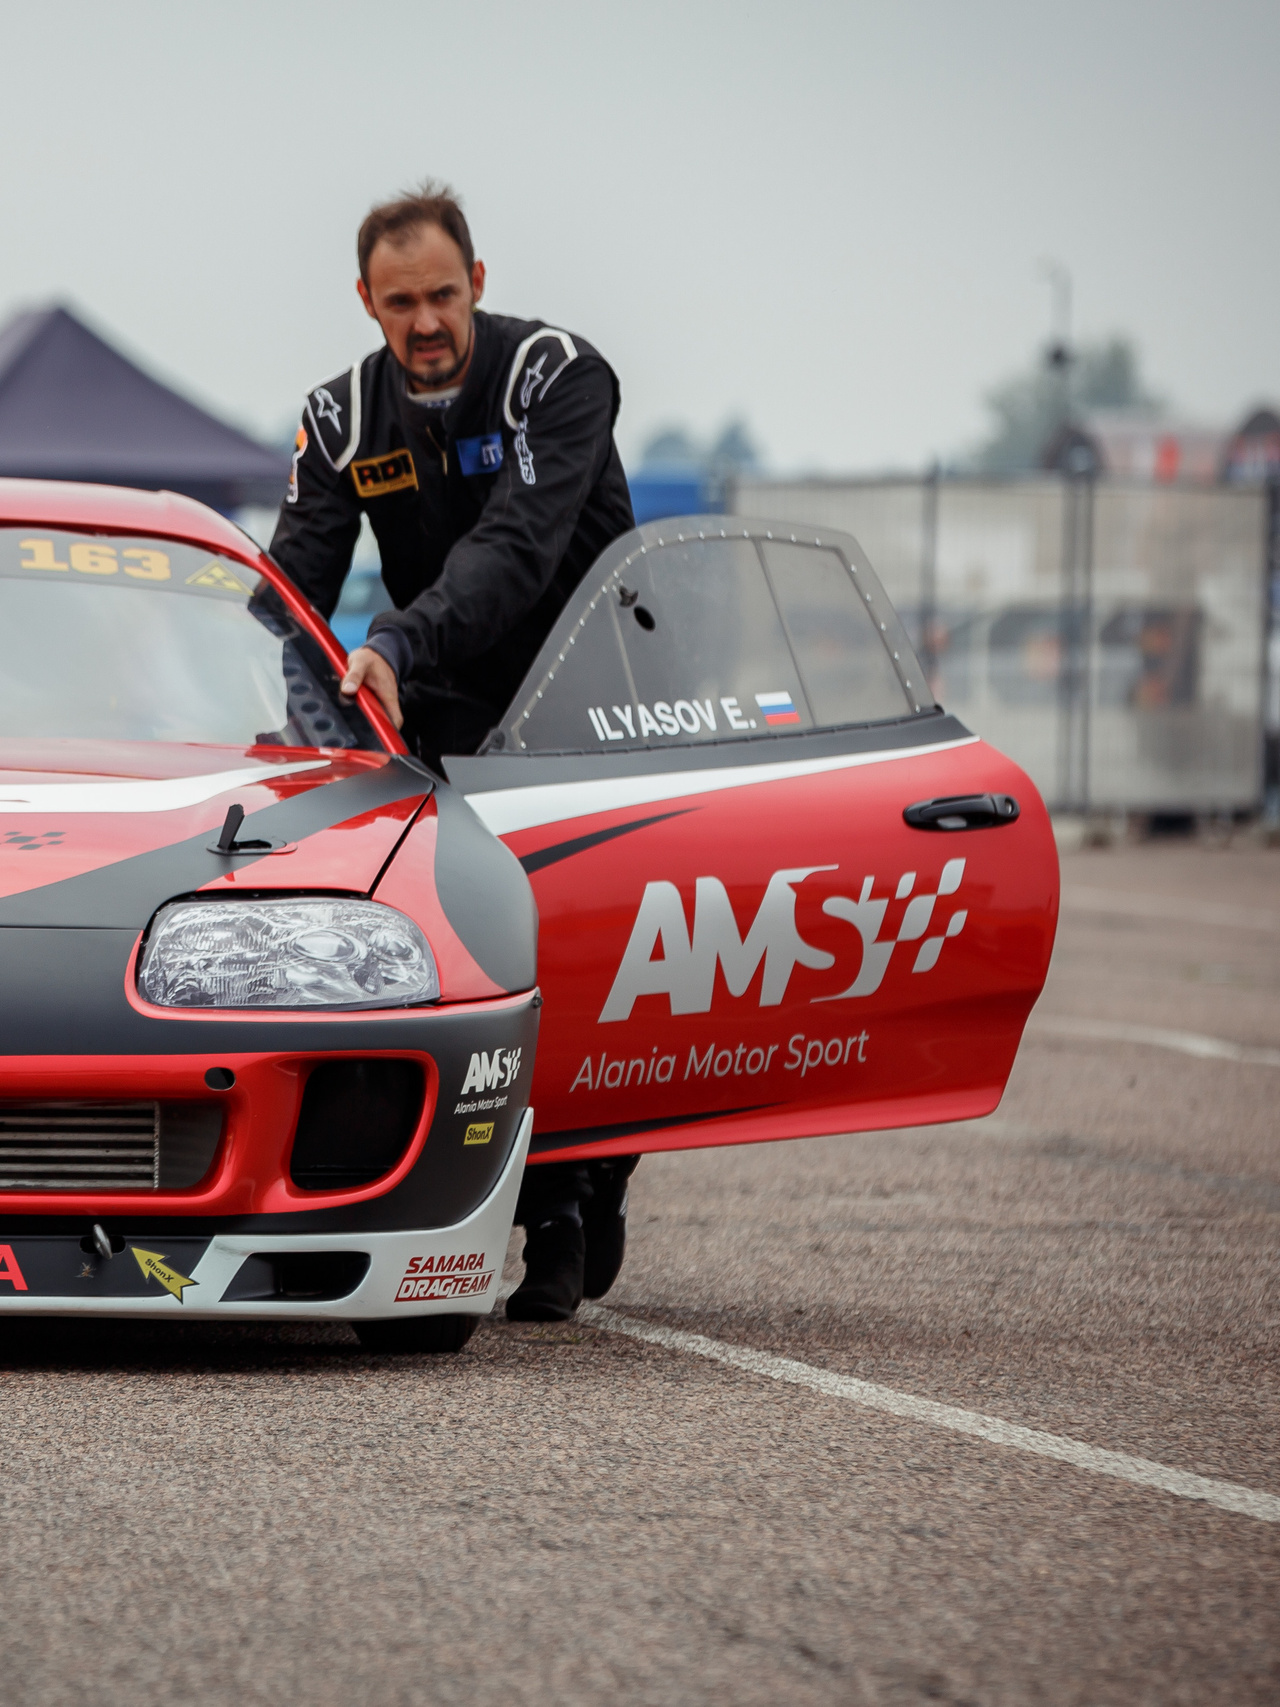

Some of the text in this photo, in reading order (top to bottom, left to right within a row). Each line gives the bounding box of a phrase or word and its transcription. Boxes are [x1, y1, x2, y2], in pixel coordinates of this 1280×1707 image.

[19, 538, 171, 581] 163
[587, 697, 757, 741] ILYASOV E.
[569, 1029, 870, 1094] Alania Motor Sport
[453, 1095, 508, 1115] Alania Motor Sport
[466, 1126, 492, 1141] ShonX
[145, 1258, 175, 1283] ShonX
[405, 1252, 485, 1275] SAMARA
